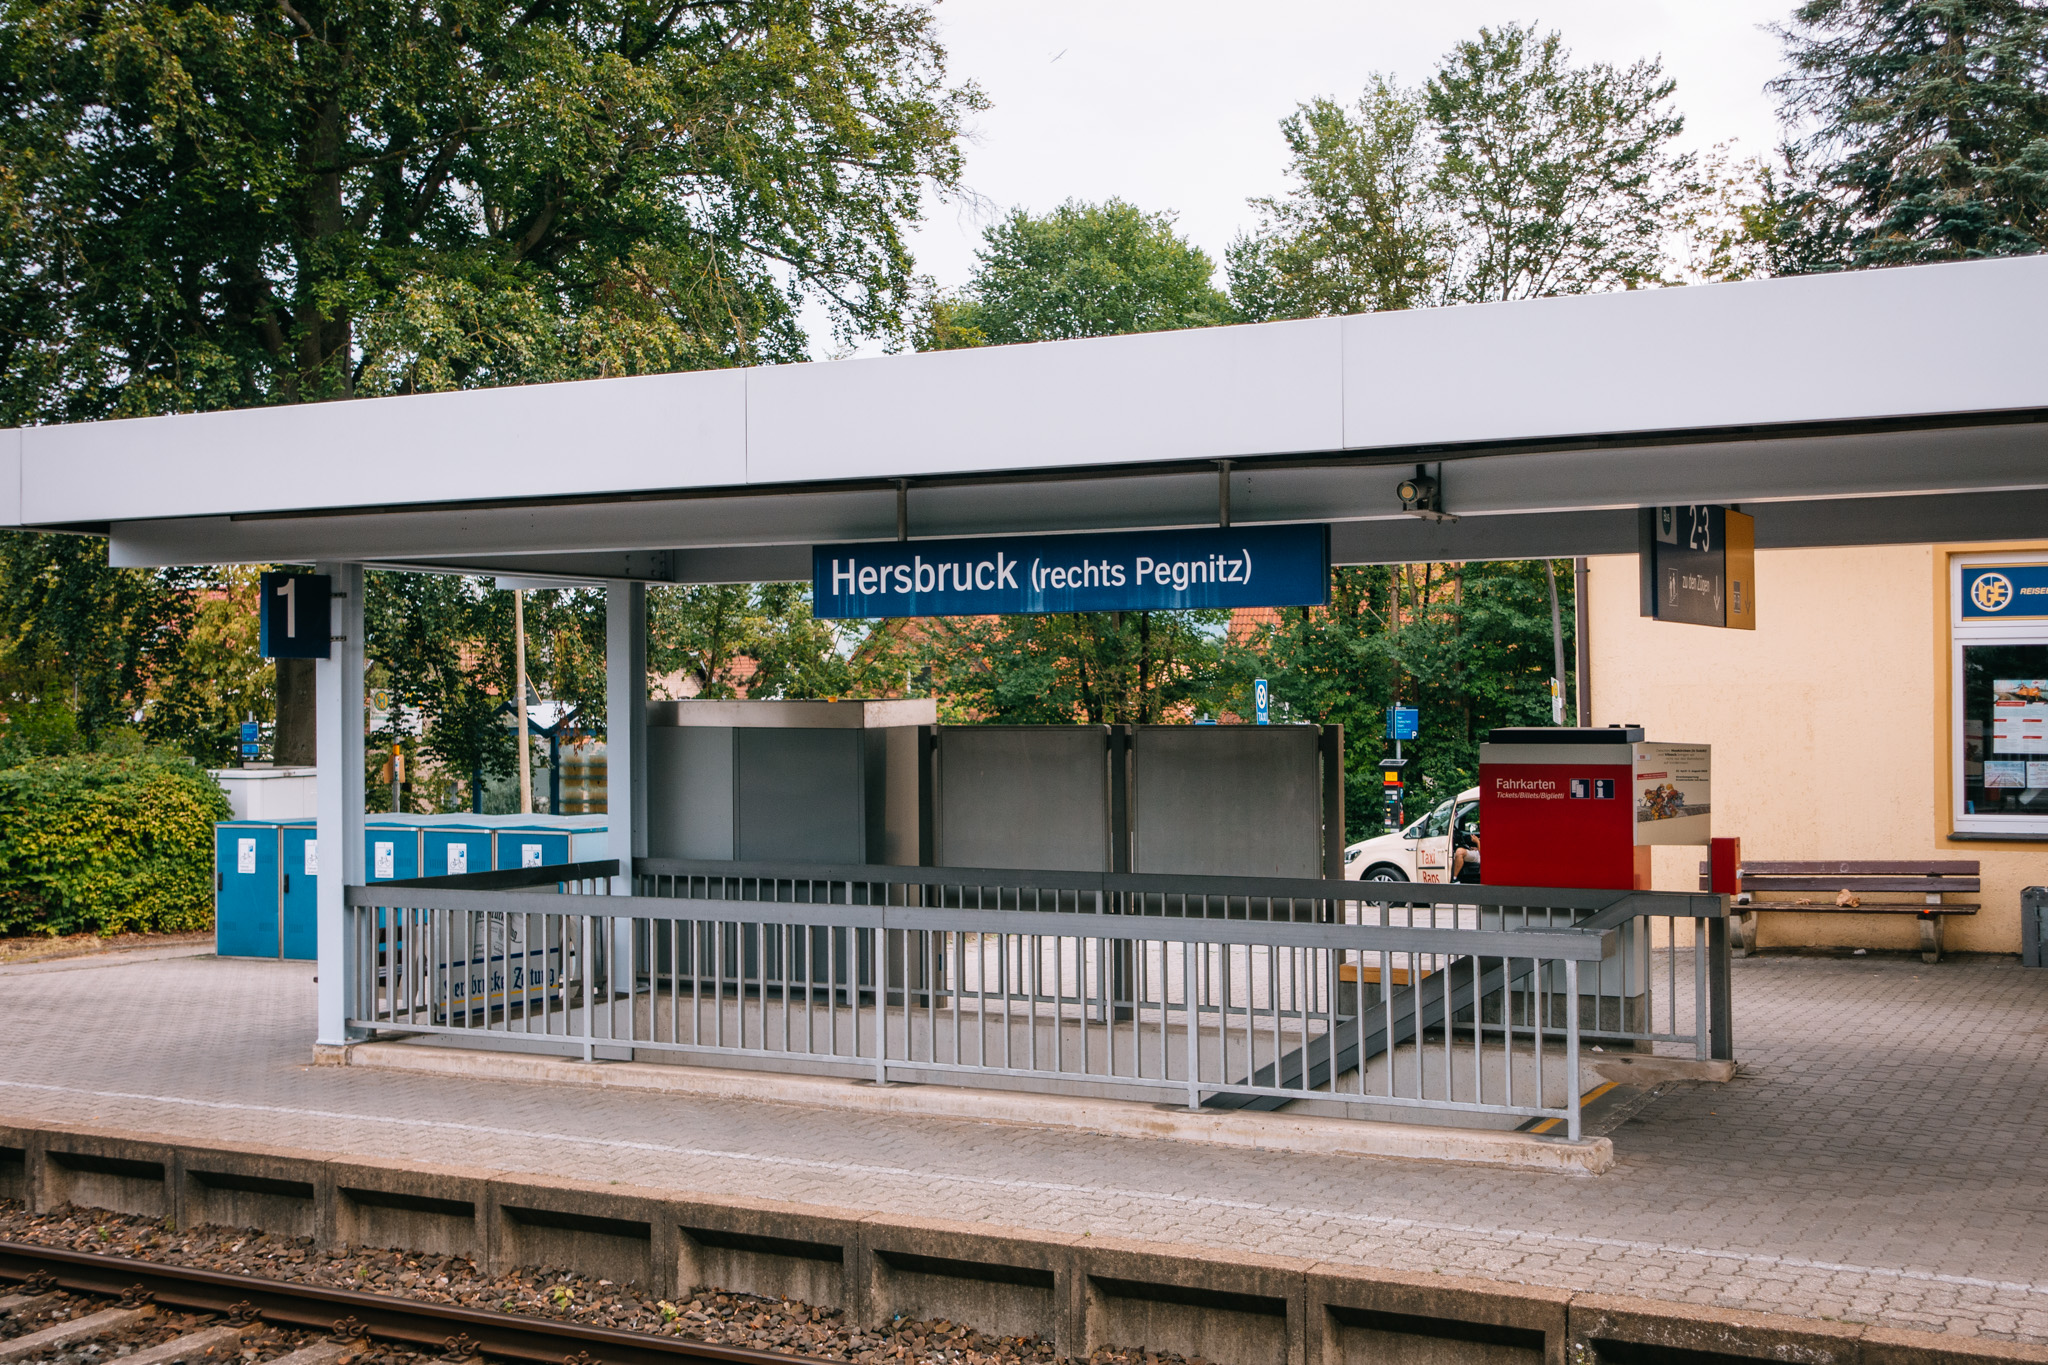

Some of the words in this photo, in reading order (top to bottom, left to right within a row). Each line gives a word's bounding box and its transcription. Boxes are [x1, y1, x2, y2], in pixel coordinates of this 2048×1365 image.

[832, 551, 1019, 596] Hersbruck
[1031, 557, 1126, 592] (rechts
[1136, 548, 1253, 592] Pegnitz)
[1978, 581, 2005, 607] IGE
[276, 578, 296, 638] 1
[1258, 712, 1268, 722] TAXI
[1496, 778, 1556, 790] Fahrkarten
[1496, 791, 1565, 801] Tickets/Billets/Biglietti
[1420, 848, 1436, 865] Taxi
